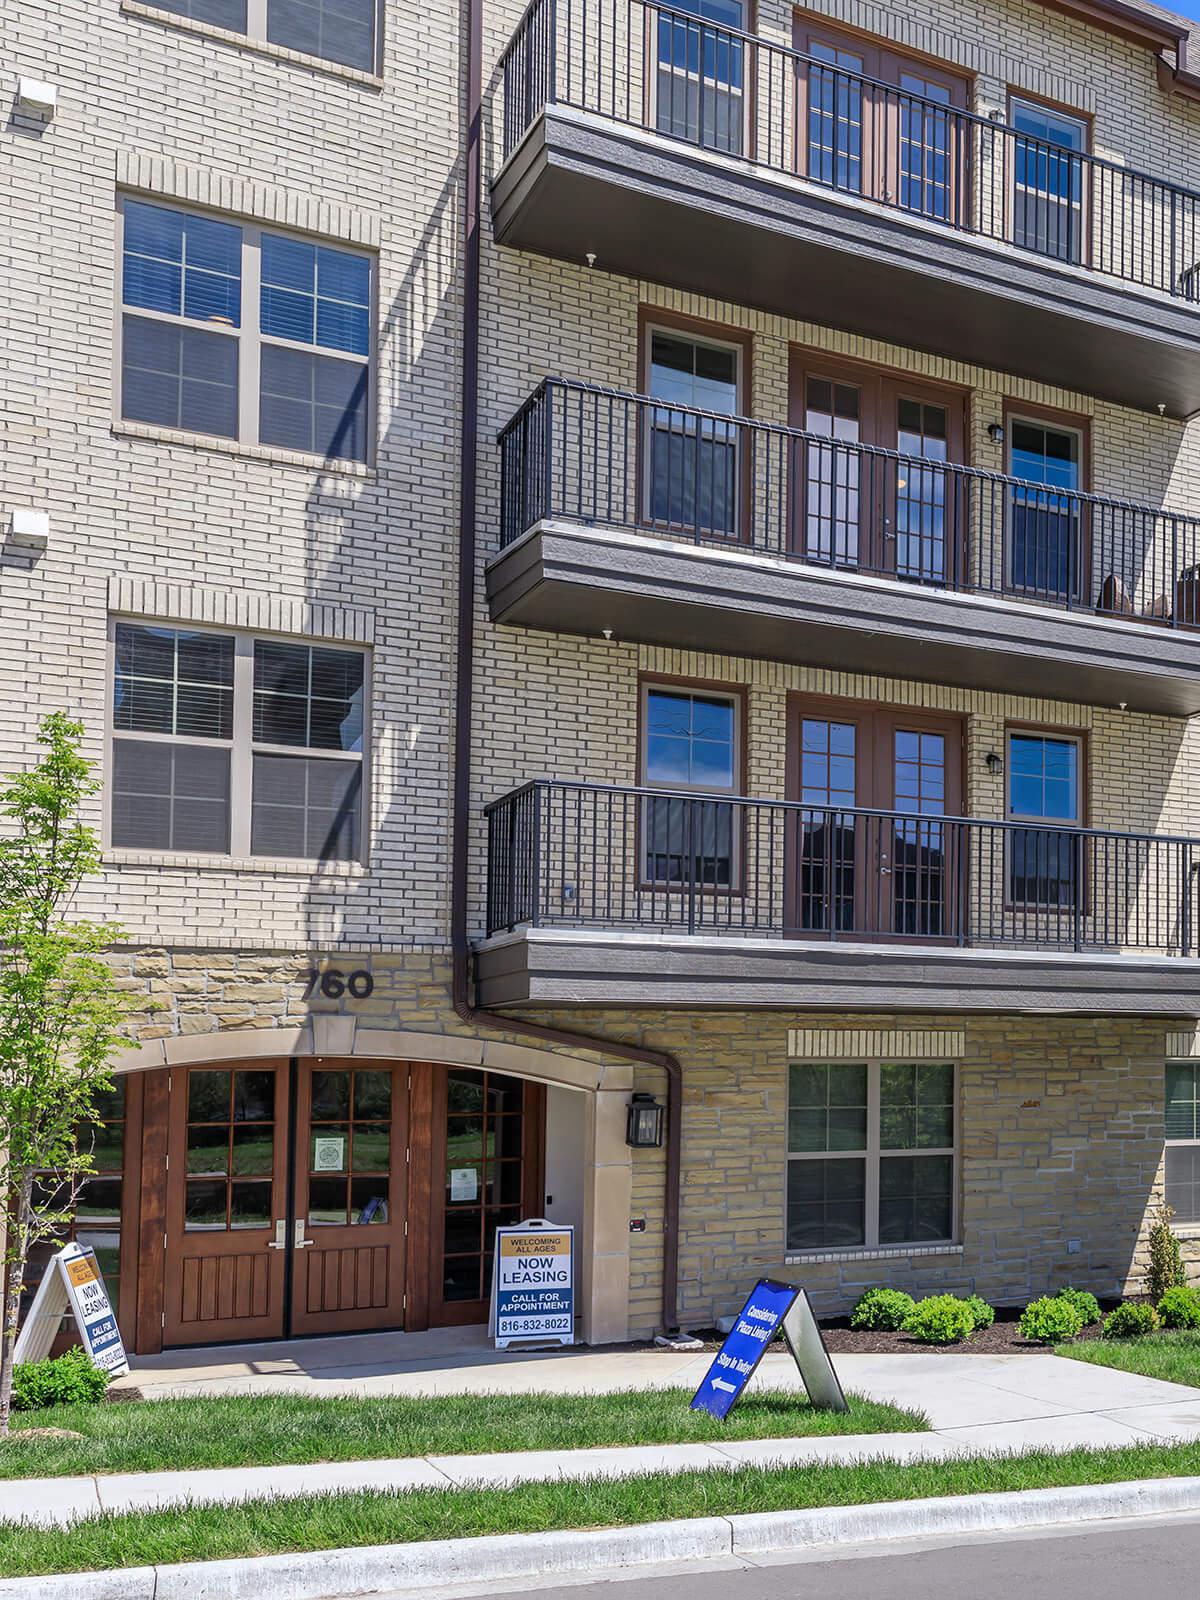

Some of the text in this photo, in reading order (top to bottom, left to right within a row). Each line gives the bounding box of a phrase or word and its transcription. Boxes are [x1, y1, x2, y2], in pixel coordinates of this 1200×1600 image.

[297, 968, 374, 1000] 760
[510, 1238, 561, 1246] WELCOMING
[516, 1244, 556, 1253] ALL AGES
[518, 1257, 554, 1270] NOW
[503, 1270, 568, 1284] LEASING
[82, 1283, 99, 1300] NOW
[511, 1293, 560, 1303] CALL FOR
[81, 1297, 108, 1317] LEASING
[500, 1301, 570, 1312] APPOINTMENT
[747, 1305, 778, 1326] Considering
[501, 1318, 569, 1332] 816-832-8022
[736, 1320, 772, 1342] Plaza Living?
[717, 1353, 730, 1368] Stop
